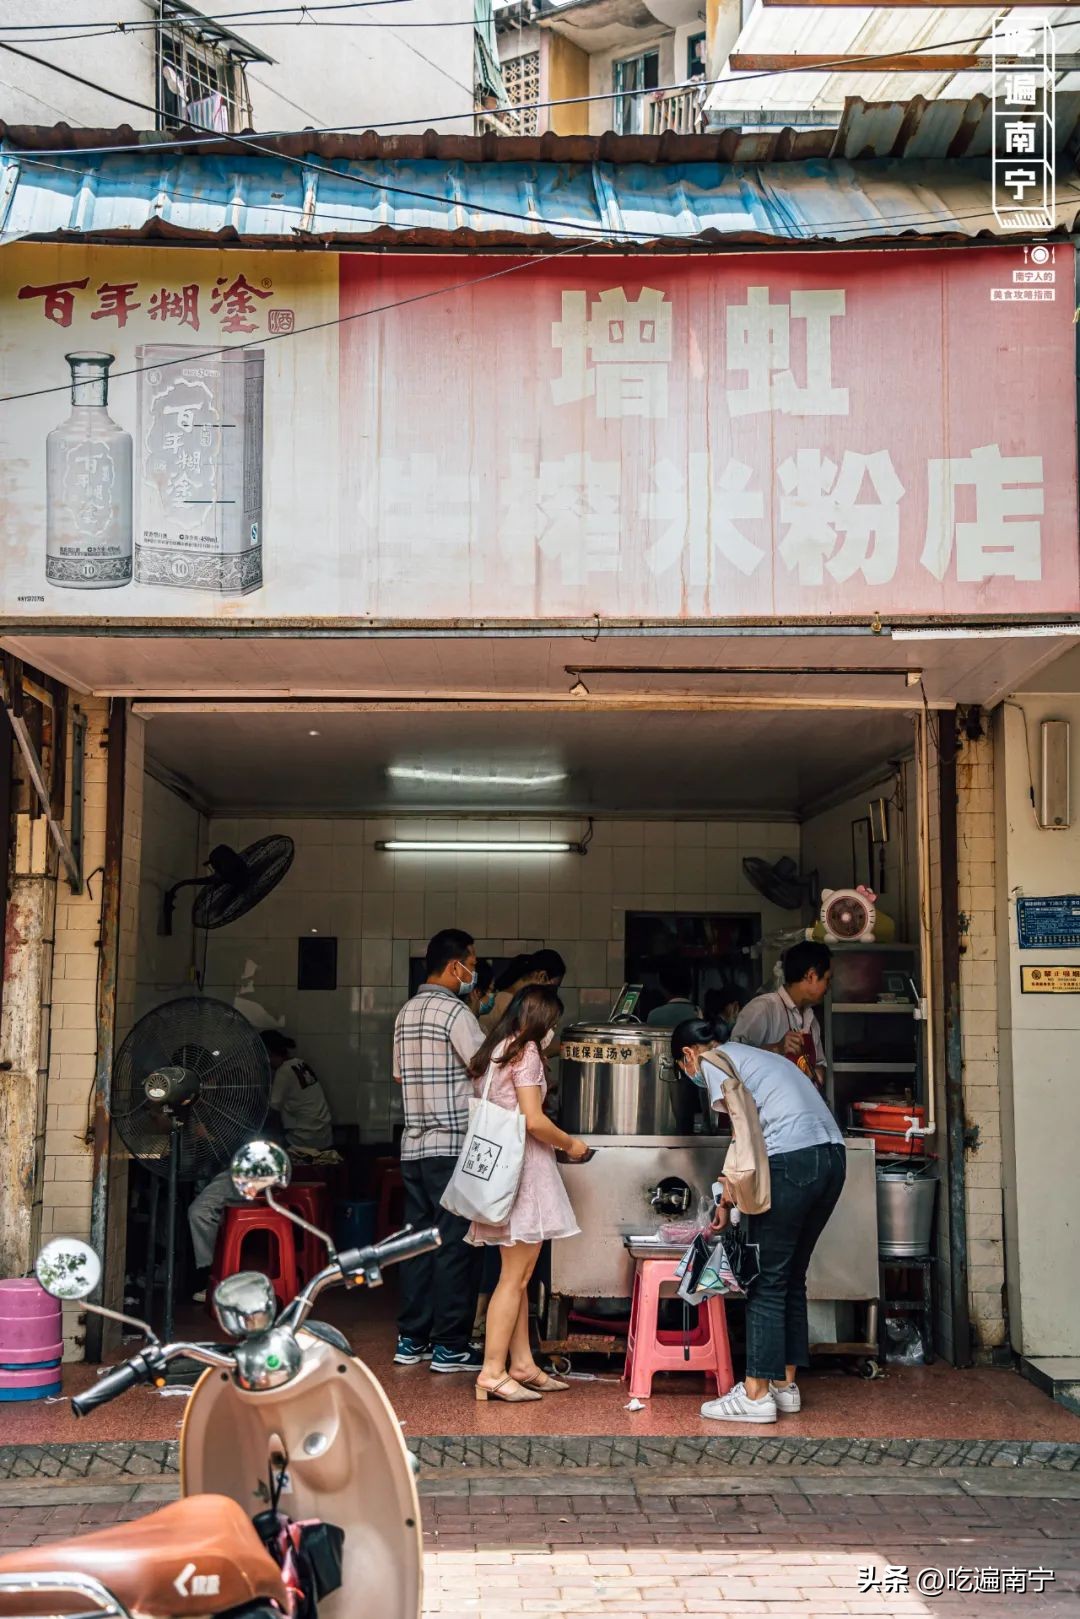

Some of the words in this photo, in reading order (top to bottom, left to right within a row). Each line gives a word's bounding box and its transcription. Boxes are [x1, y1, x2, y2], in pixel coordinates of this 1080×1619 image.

[18, 274, 274, 334] 百年糊涂
[551, 286, 849, 418] 增虹
[358, 443, 1044, 587] 生榨米粉店
